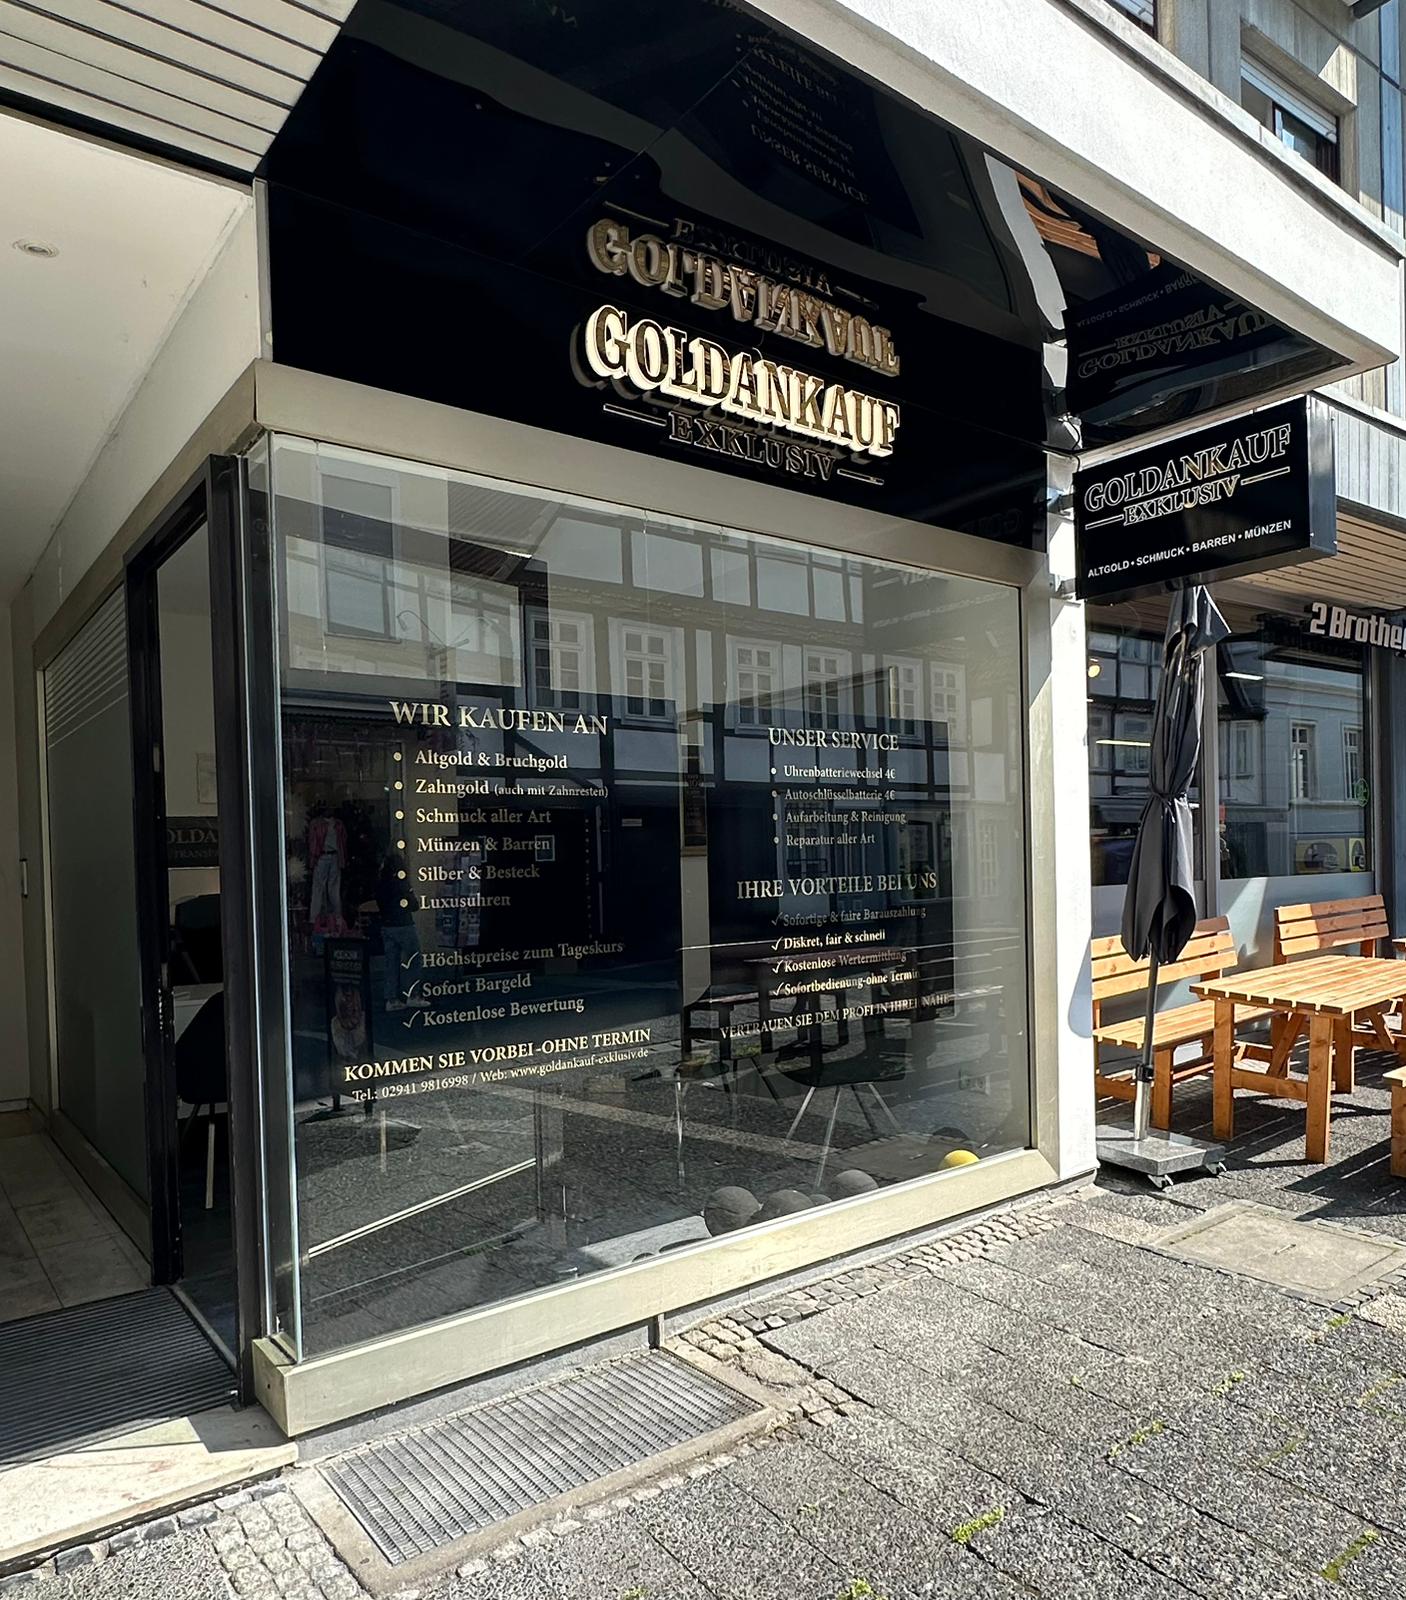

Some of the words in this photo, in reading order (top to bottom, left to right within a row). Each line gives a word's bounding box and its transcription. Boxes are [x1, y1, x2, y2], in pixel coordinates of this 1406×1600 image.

[585, 304, 900, 458] GOLDANKAUF
[668, 411, 836, 481] EXKLUSIV
[1084, 423, 1291, 512] GOLDANKAUF
[1123, 474, 1240, 526] EXKLUSIV
[1088, 560, 1130, 578] ALTGOLD
[1136, 546, 1185, 566] SCHMUCK
[1192, 534, 1236, 553] BARREN
[1244, 520, 1292, 539] MÜNZEN
[1310, 602, 1327, 635] 2
[1329, 606, 1406, 651] Brothe
[389, 701, 451, 727] WIR
[458, 705, 565, 733] KAUFEN
[573, 714, 608, 736] AN
[768, 727, 828, 748] UNSER
[831, 731, 899, 750] SERVICE
[415, 751, 472, 769] Altgold
[478, 753, 491, 766] &
[495, 752, 568, 772] Bruchgold
[784, 765, 883, 779] Uhrenbatteriewechsel
[885, 768, 896, 779] 4€
[415, 779, 489, 798] Zahngold
[494, 785, 524, 797] (auch
[527, 785, 546, 796] mit
[549, 785, 609, 798] Zahnresten)
[785, 788, 883, 800] Autoschlüsselbatterie
[884, 790, 896, 800] 4€
[416, 808, 487, 823] Schmuck
[491, 809, 522, 823] aller
[527, 809, 551, 823] Art
[785, 811, 849, 825] Aufarbeitung
[851, 811, 859, 821] &
[861, 811, 907, 824] Reinigung
[417, 837, 480, 852] Münzen
[484, 838, 498, 851] &
[502, 837, 550, 851] Barren
[786, 834, 834, 848] Reparatur
[837, 833, 857, 844] aller
[860, 833, 875, 844] Art
[418, 866, 464, 881] Silber
[468, 866, 481, 880] &
[486, 864, 540, 879] Besteck
[737, 879, 784, 899] IHRE
[788, 876, 874, 896] VORTEILE
[878, 875, 902, 890] BEI
[906, 872, 937, 890] UNS
[420, 893, 511, 910] Luxusuhren
[783, 913, 827, 927] Sofortige
[830, 912, 839, 922] &
[840, 910, 861, 921] faire
[863, 905, 926, 920] Barauszahlung
[784, 936, 823, 950] Diskret,
[826, 934, 842, 946] fair
[845, 933, 853, 943] &
[854, 929, 885, 943] schnell
[422, 949, 520, 969] Höchstpreise
[523, 947, 554, 960] zum
[558, 941, 624, 960] Tageskurs
[785, 958, 837, 973] Kostenlose
[839, 951, 907, 967] Wertermittlung
[423, 979, 470, 997] Sofort
[476, 973, 532, 994] Bargeld
[784, 973, 888, 995] Sofortbedienung-ohne
[423, 1006, 506, 1027] Kostenlose
[510, 997, 585, 1018] Bewertung
[720, 1018, 794, 1039] VERTRAUEN
[795, 1013, 813, 1027] SIE
[815, 1010, 840, 1024] DEM
[842, 1006, 874, 1020] PROFI
[875, 1003, 888, 1014] IN
[344, 1055, 433, 1082] KOMMEN
[439, 1051, 466, 1069] SIE
[592, 1028, 651, 1048] TERMIN
[352, 1088, 378, 1102] Tel.:
[382, 1084, 417, 1098] 02941
[421, 1075, 469, 1092] 9816998
[480, 1069, 508, 1082] Web:
[510, 1048, 649, 1078] www.goldankauf-exklusiv.de
